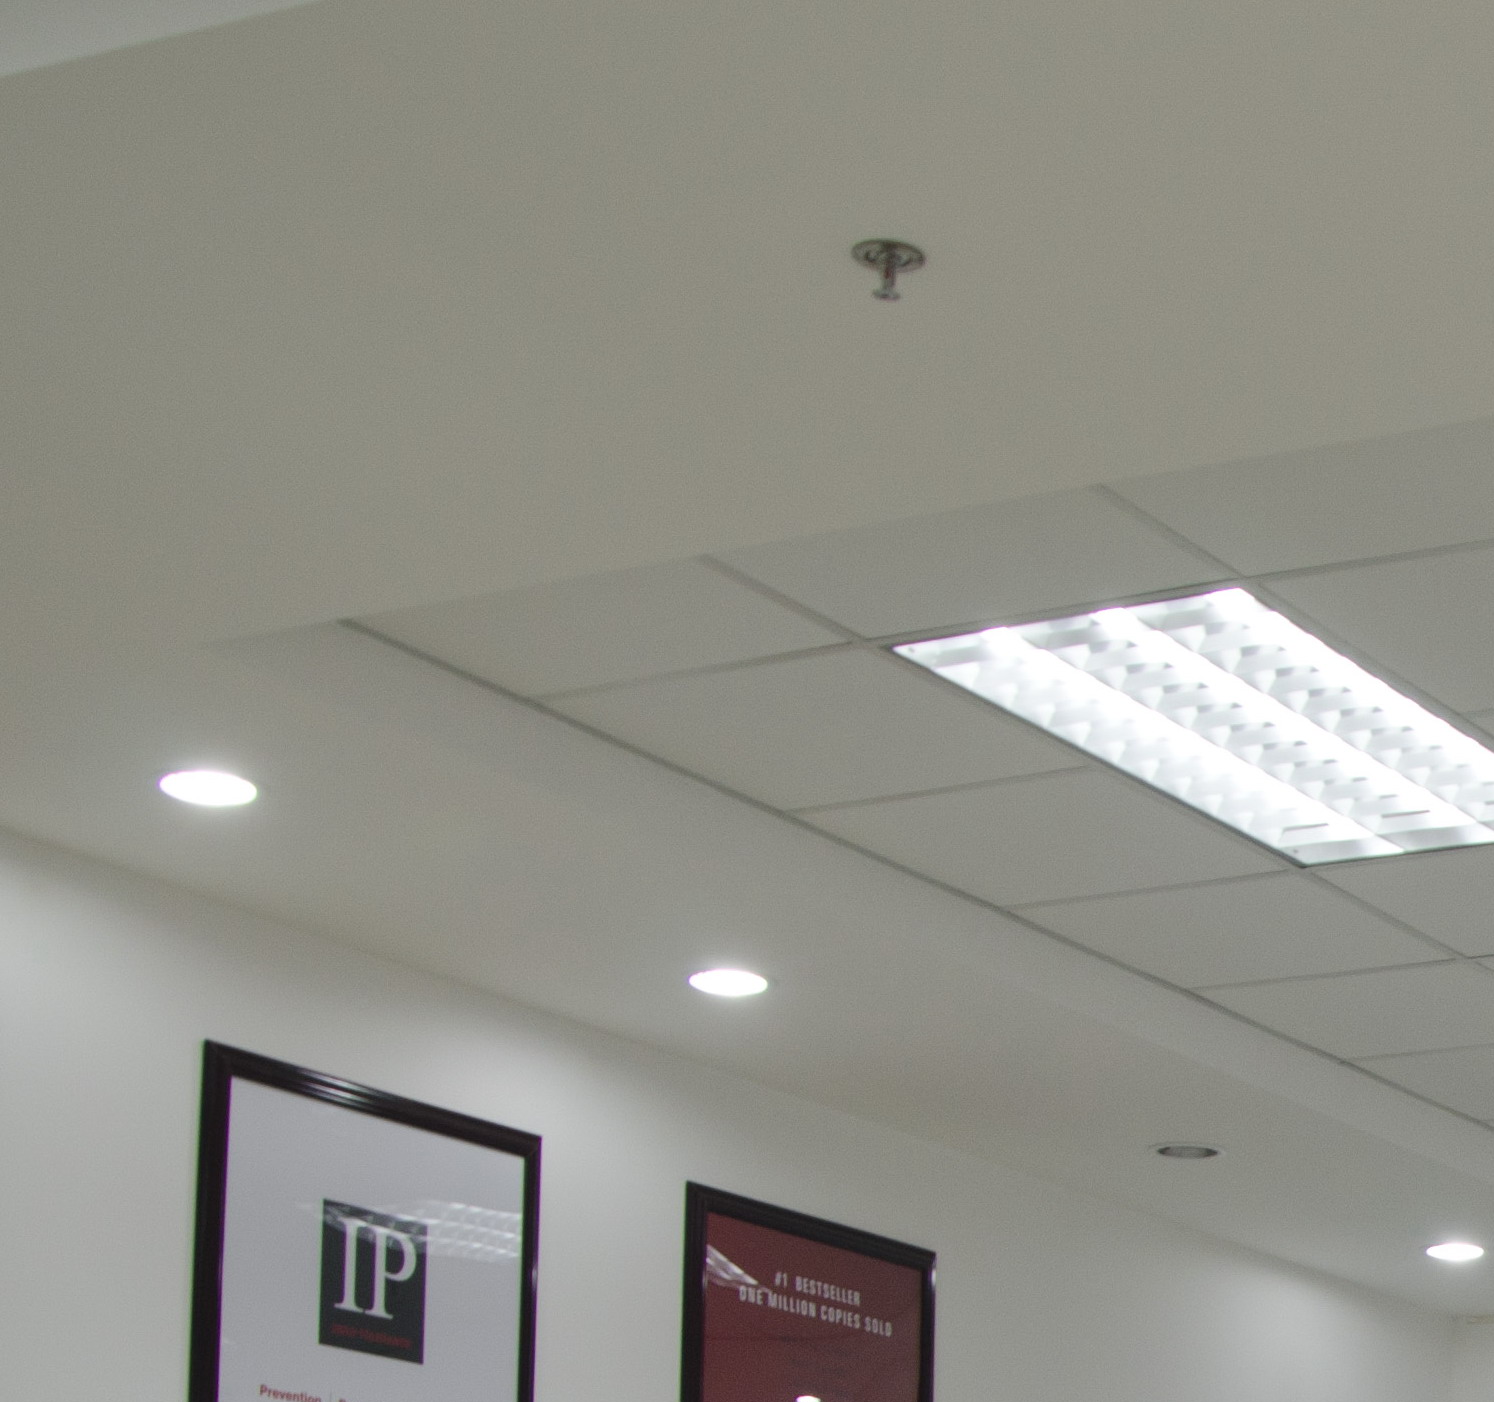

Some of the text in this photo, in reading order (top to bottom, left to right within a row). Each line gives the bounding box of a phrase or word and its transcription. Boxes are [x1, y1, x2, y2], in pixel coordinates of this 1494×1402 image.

[333, 1217, 417, 1319] IP
[774, 1271, 860, 1307] #1 BESTSELLER
[740, 1285, 892, 1337] ONE MILLION COPIES SOLD
